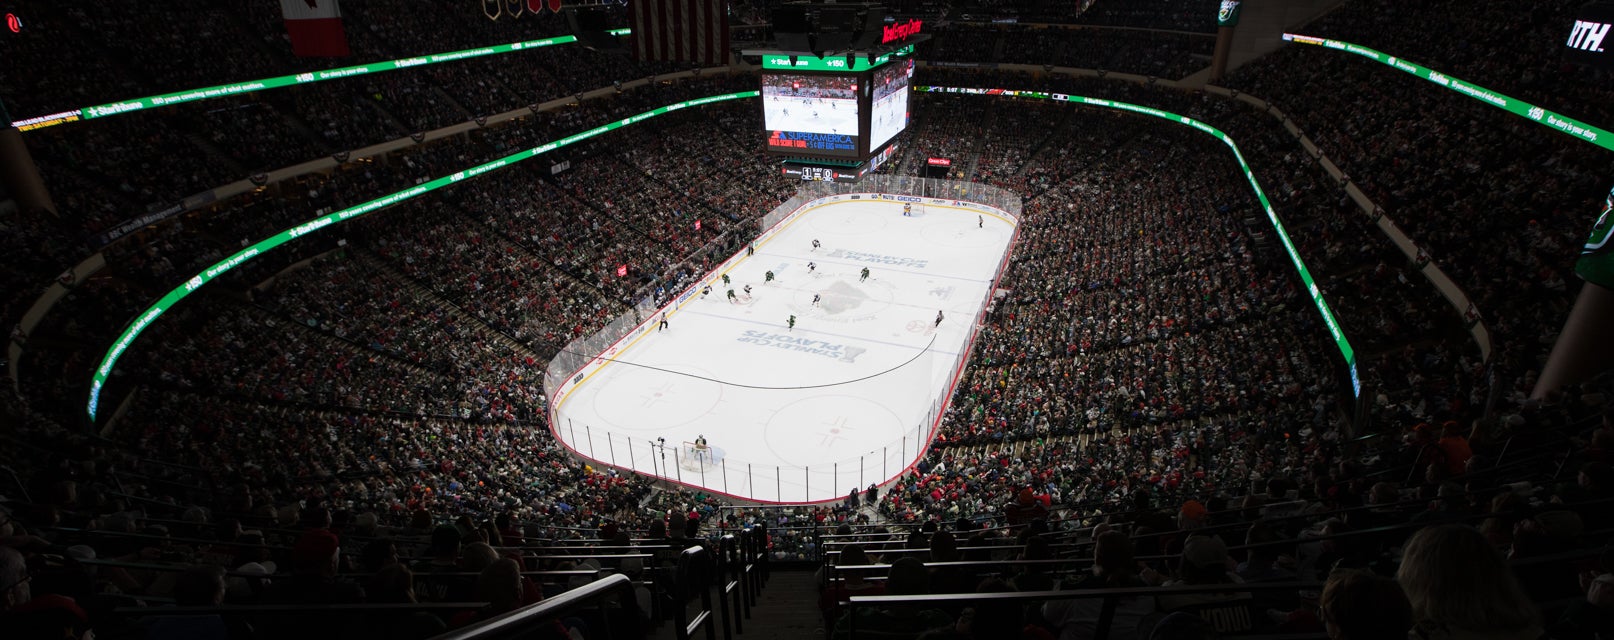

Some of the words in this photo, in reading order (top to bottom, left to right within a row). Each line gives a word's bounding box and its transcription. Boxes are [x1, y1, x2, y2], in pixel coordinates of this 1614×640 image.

[302, 72, 314, 82] 150
[164, 96, 180, 104] years
[180, 92, 206, 100] covering
[205, 89, 220, 97] more
[98, 102, 143, 116] StarTribune
[788, 132, 854, 144] SUPERAMERICA
[190, 274, 202, 289] 150
[680, 286, 697, 303] GEICO
[736, 337, 770, 346] CUP
[742, 330, 842, 351] PLAYOFFS
[770, 342, 842, 358] STANLEY
